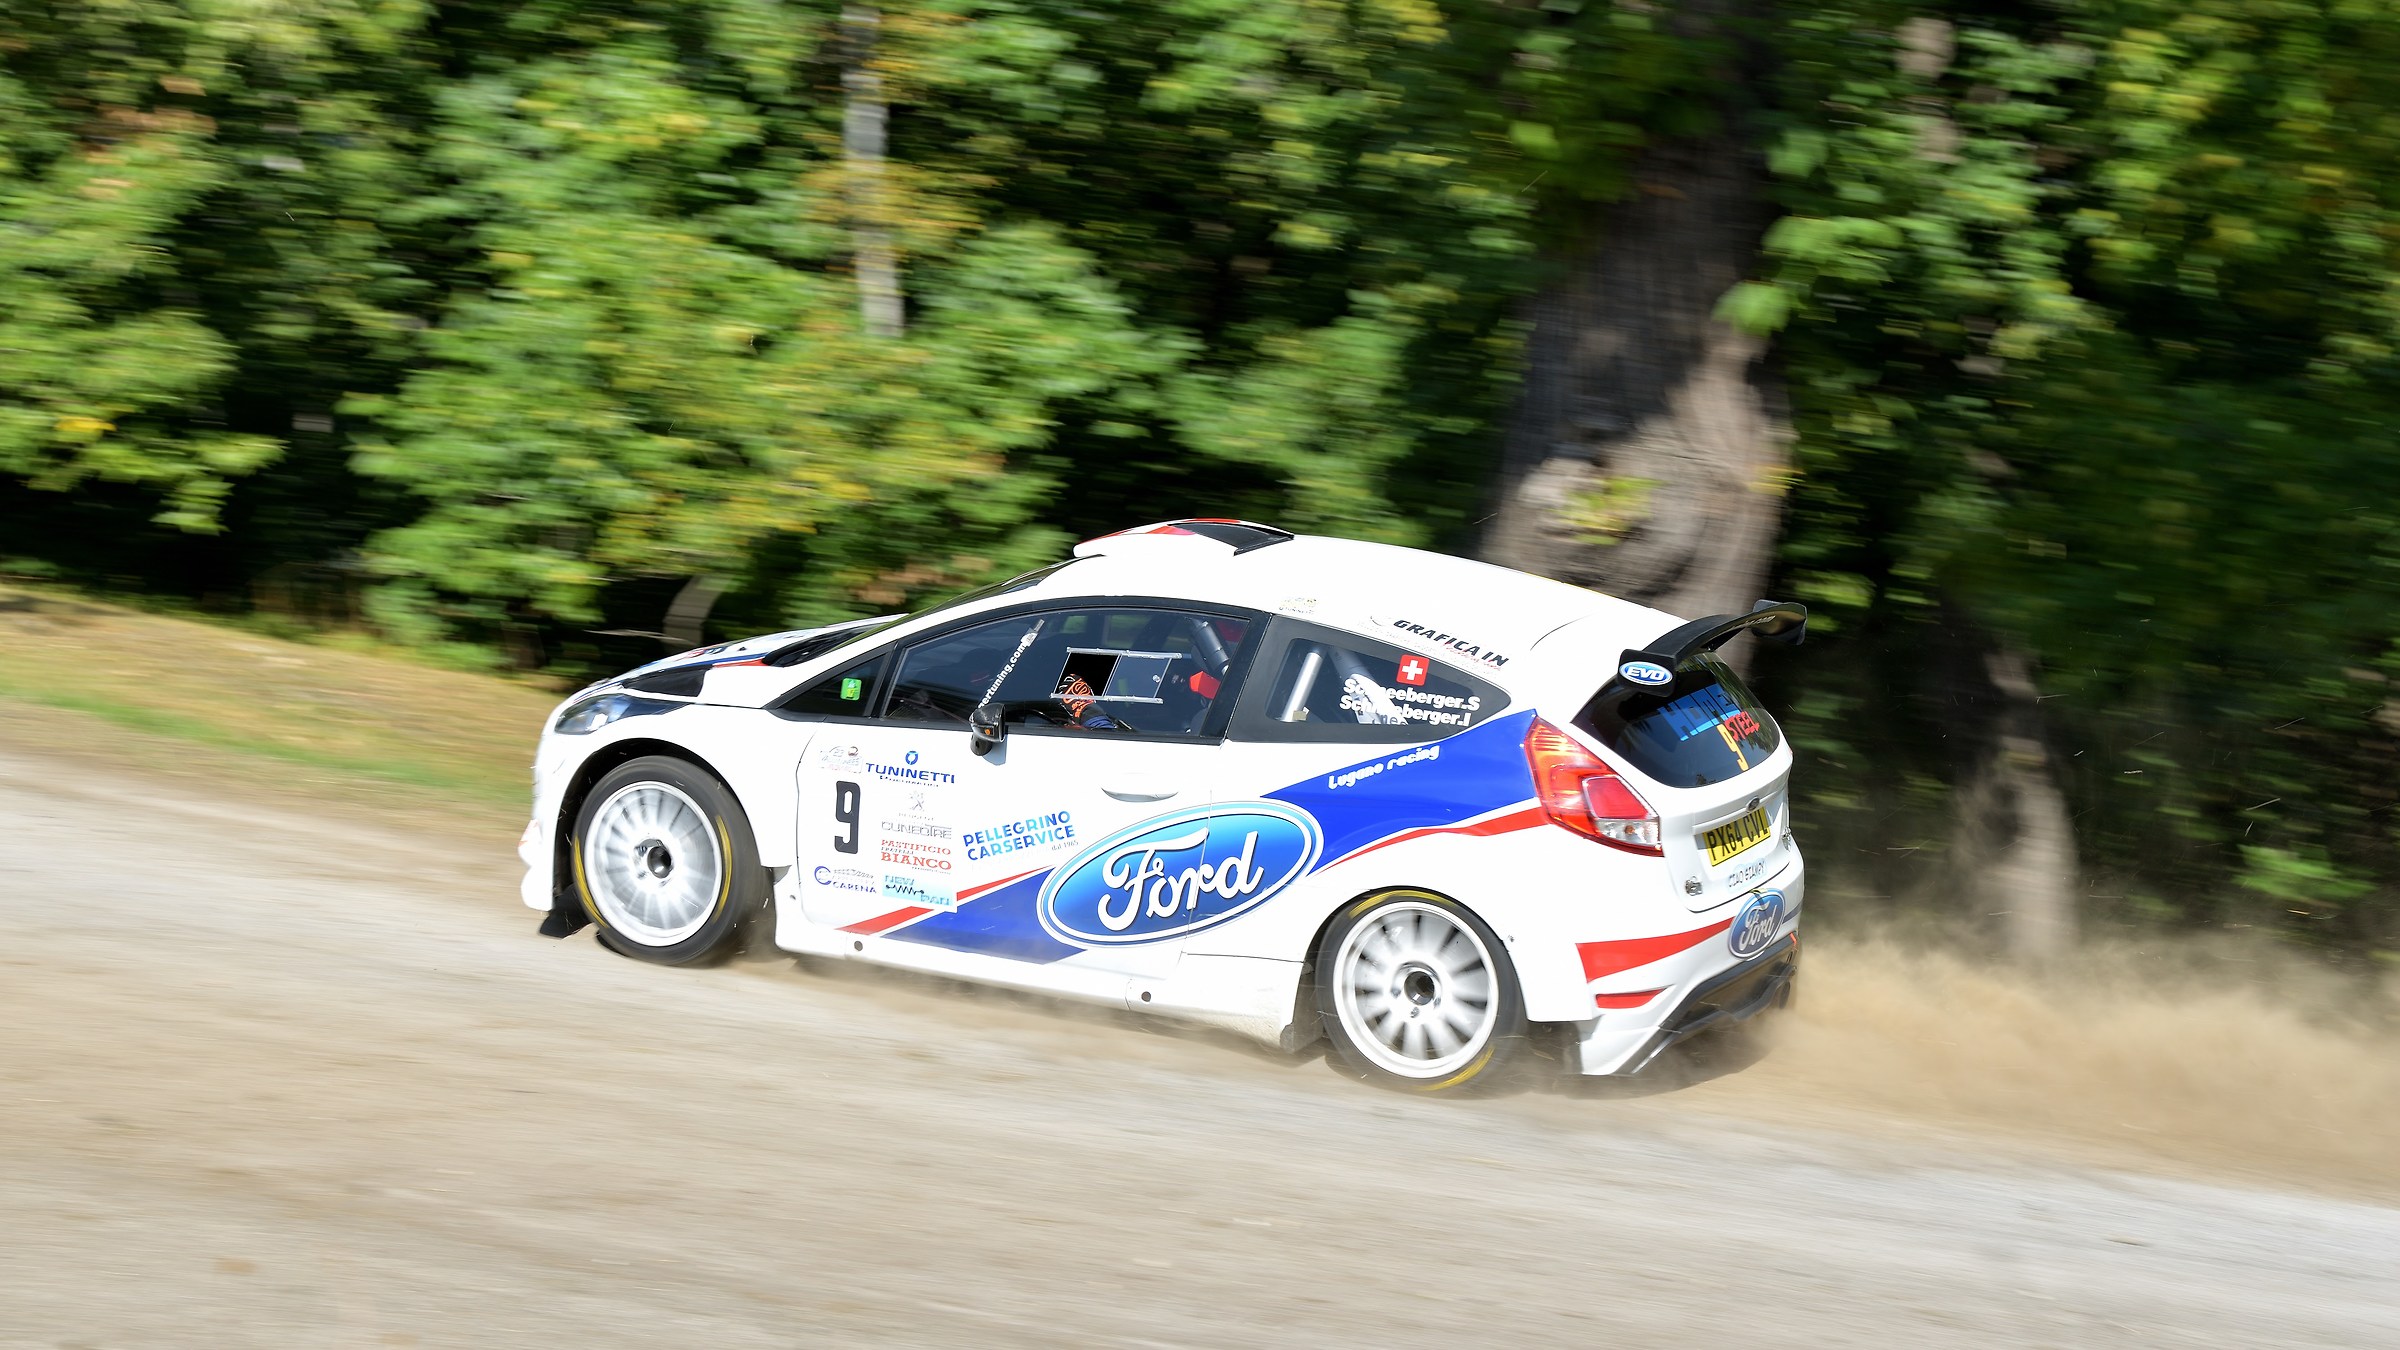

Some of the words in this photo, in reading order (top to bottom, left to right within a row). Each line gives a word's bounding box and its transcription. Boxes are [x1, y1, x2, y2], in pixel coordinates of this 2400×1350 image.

[1393, 619, 1480, 656] GRAFICA
[1481, 651, 1510, 667] IN
[1626, 666, 1665, 681] EVO
[1343, 678, 1481, 712] Sceeberger.S
[1716, 723, 1749, 772] 9
[865, 762, 955, 784] TUNINETTI
[1328, 763, 1385, 790] Lugano
[1386, 745, 1440, 770] racing
[834, 780, 861, 854] 9
[963, 811, 1071, 847] PELLEGRINO
[881, 839, 952, 856] PASTIFICIO
[967, 825, 1076, 861] CARSERVICE
[1708, 821, 1743, 862] PX64
[881, 851, 952, 871] BIANCO
[1097, 827, 1265, 931] Ford
[1738, 901, 1778, 951] Ford
